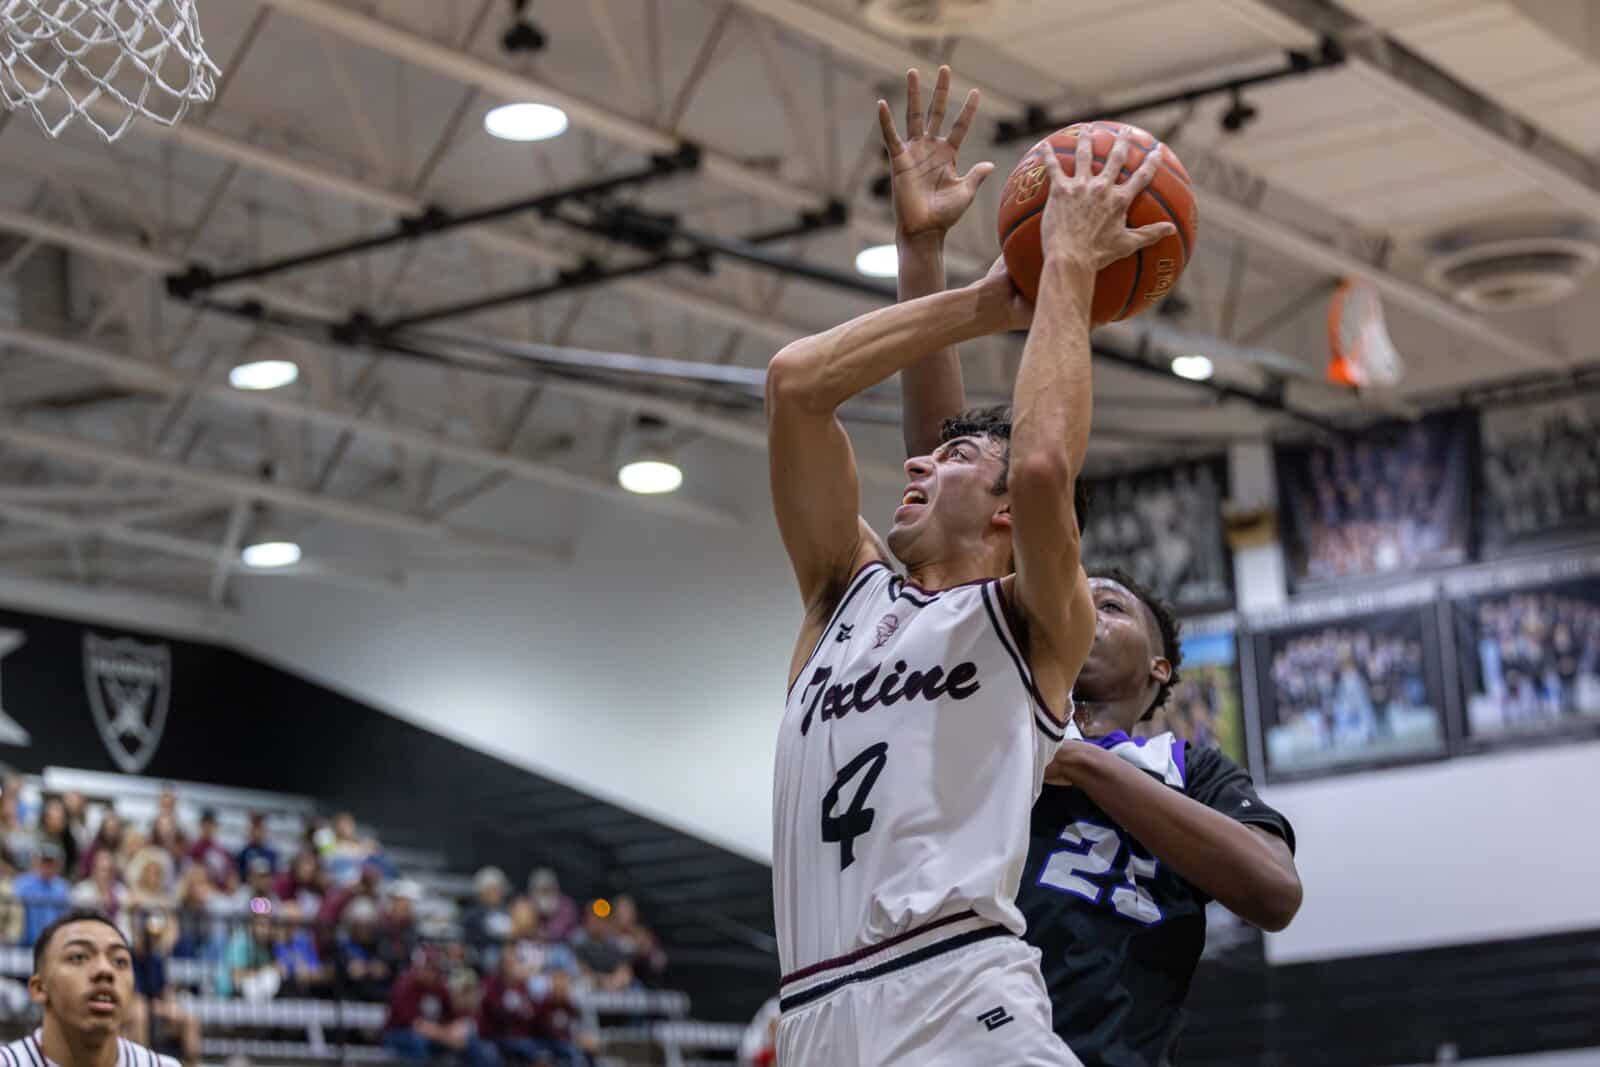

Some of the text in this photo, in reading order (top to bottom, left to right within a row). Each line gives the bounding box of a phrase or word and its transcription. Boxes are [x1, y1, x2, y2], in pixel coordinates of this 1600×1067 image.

[801, 660, 980, 736] Texline
[821, 742, 888, 870] 4
[1037, 819, 1164, 927] 25
